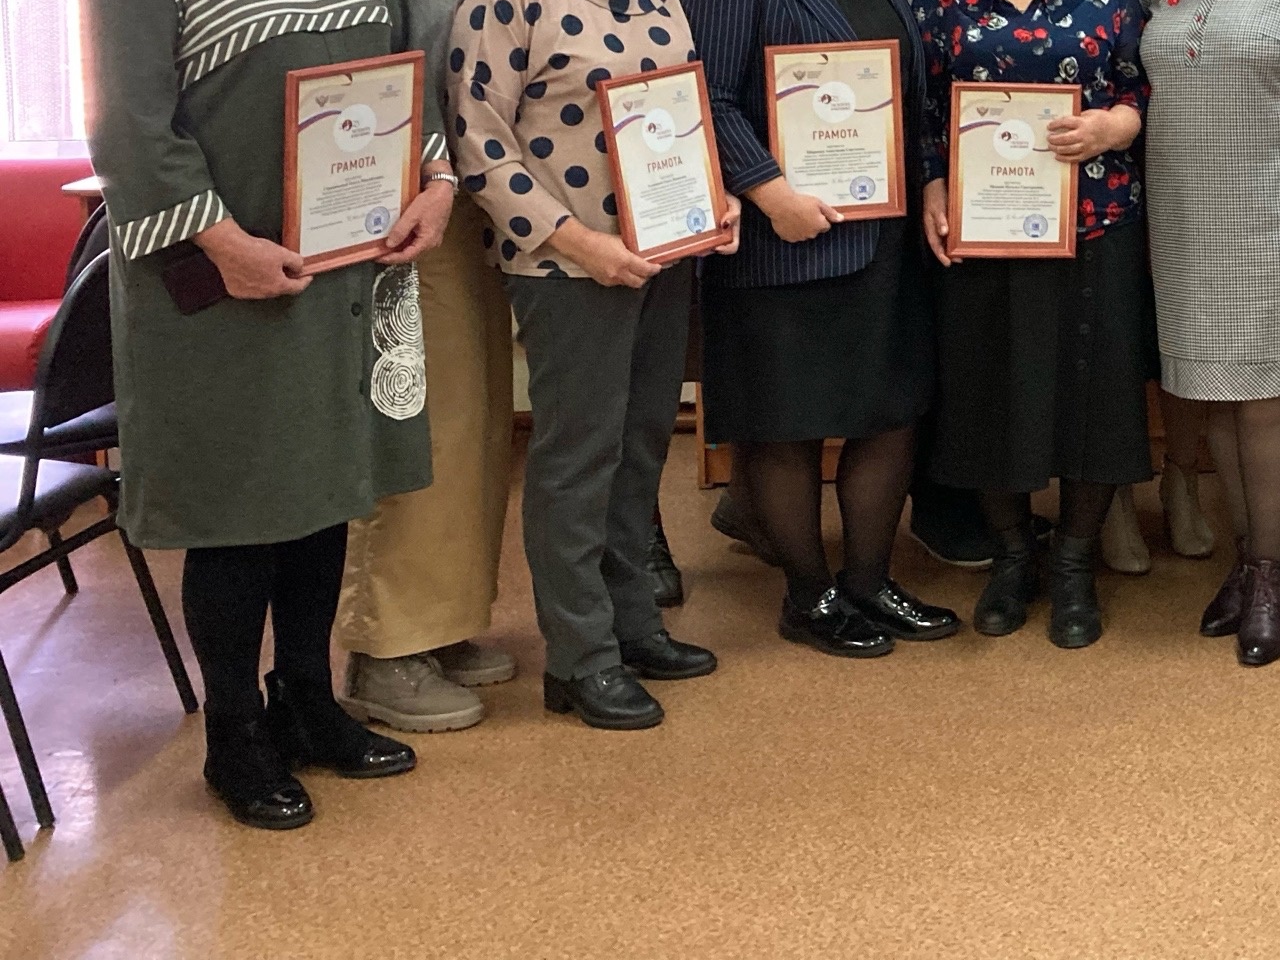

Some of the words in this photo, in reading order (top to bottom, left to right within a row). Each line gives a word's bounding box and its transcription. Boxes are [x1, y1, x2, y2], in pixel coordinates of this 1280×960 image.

[812, 128, 859, 141] ГРАМОТА
[331, 155, 377, 175] ГРАМОТА
[647, 155, 683, 174] ГРАМОТА
[990, 166, 1035, 177] ГРАМОТА
